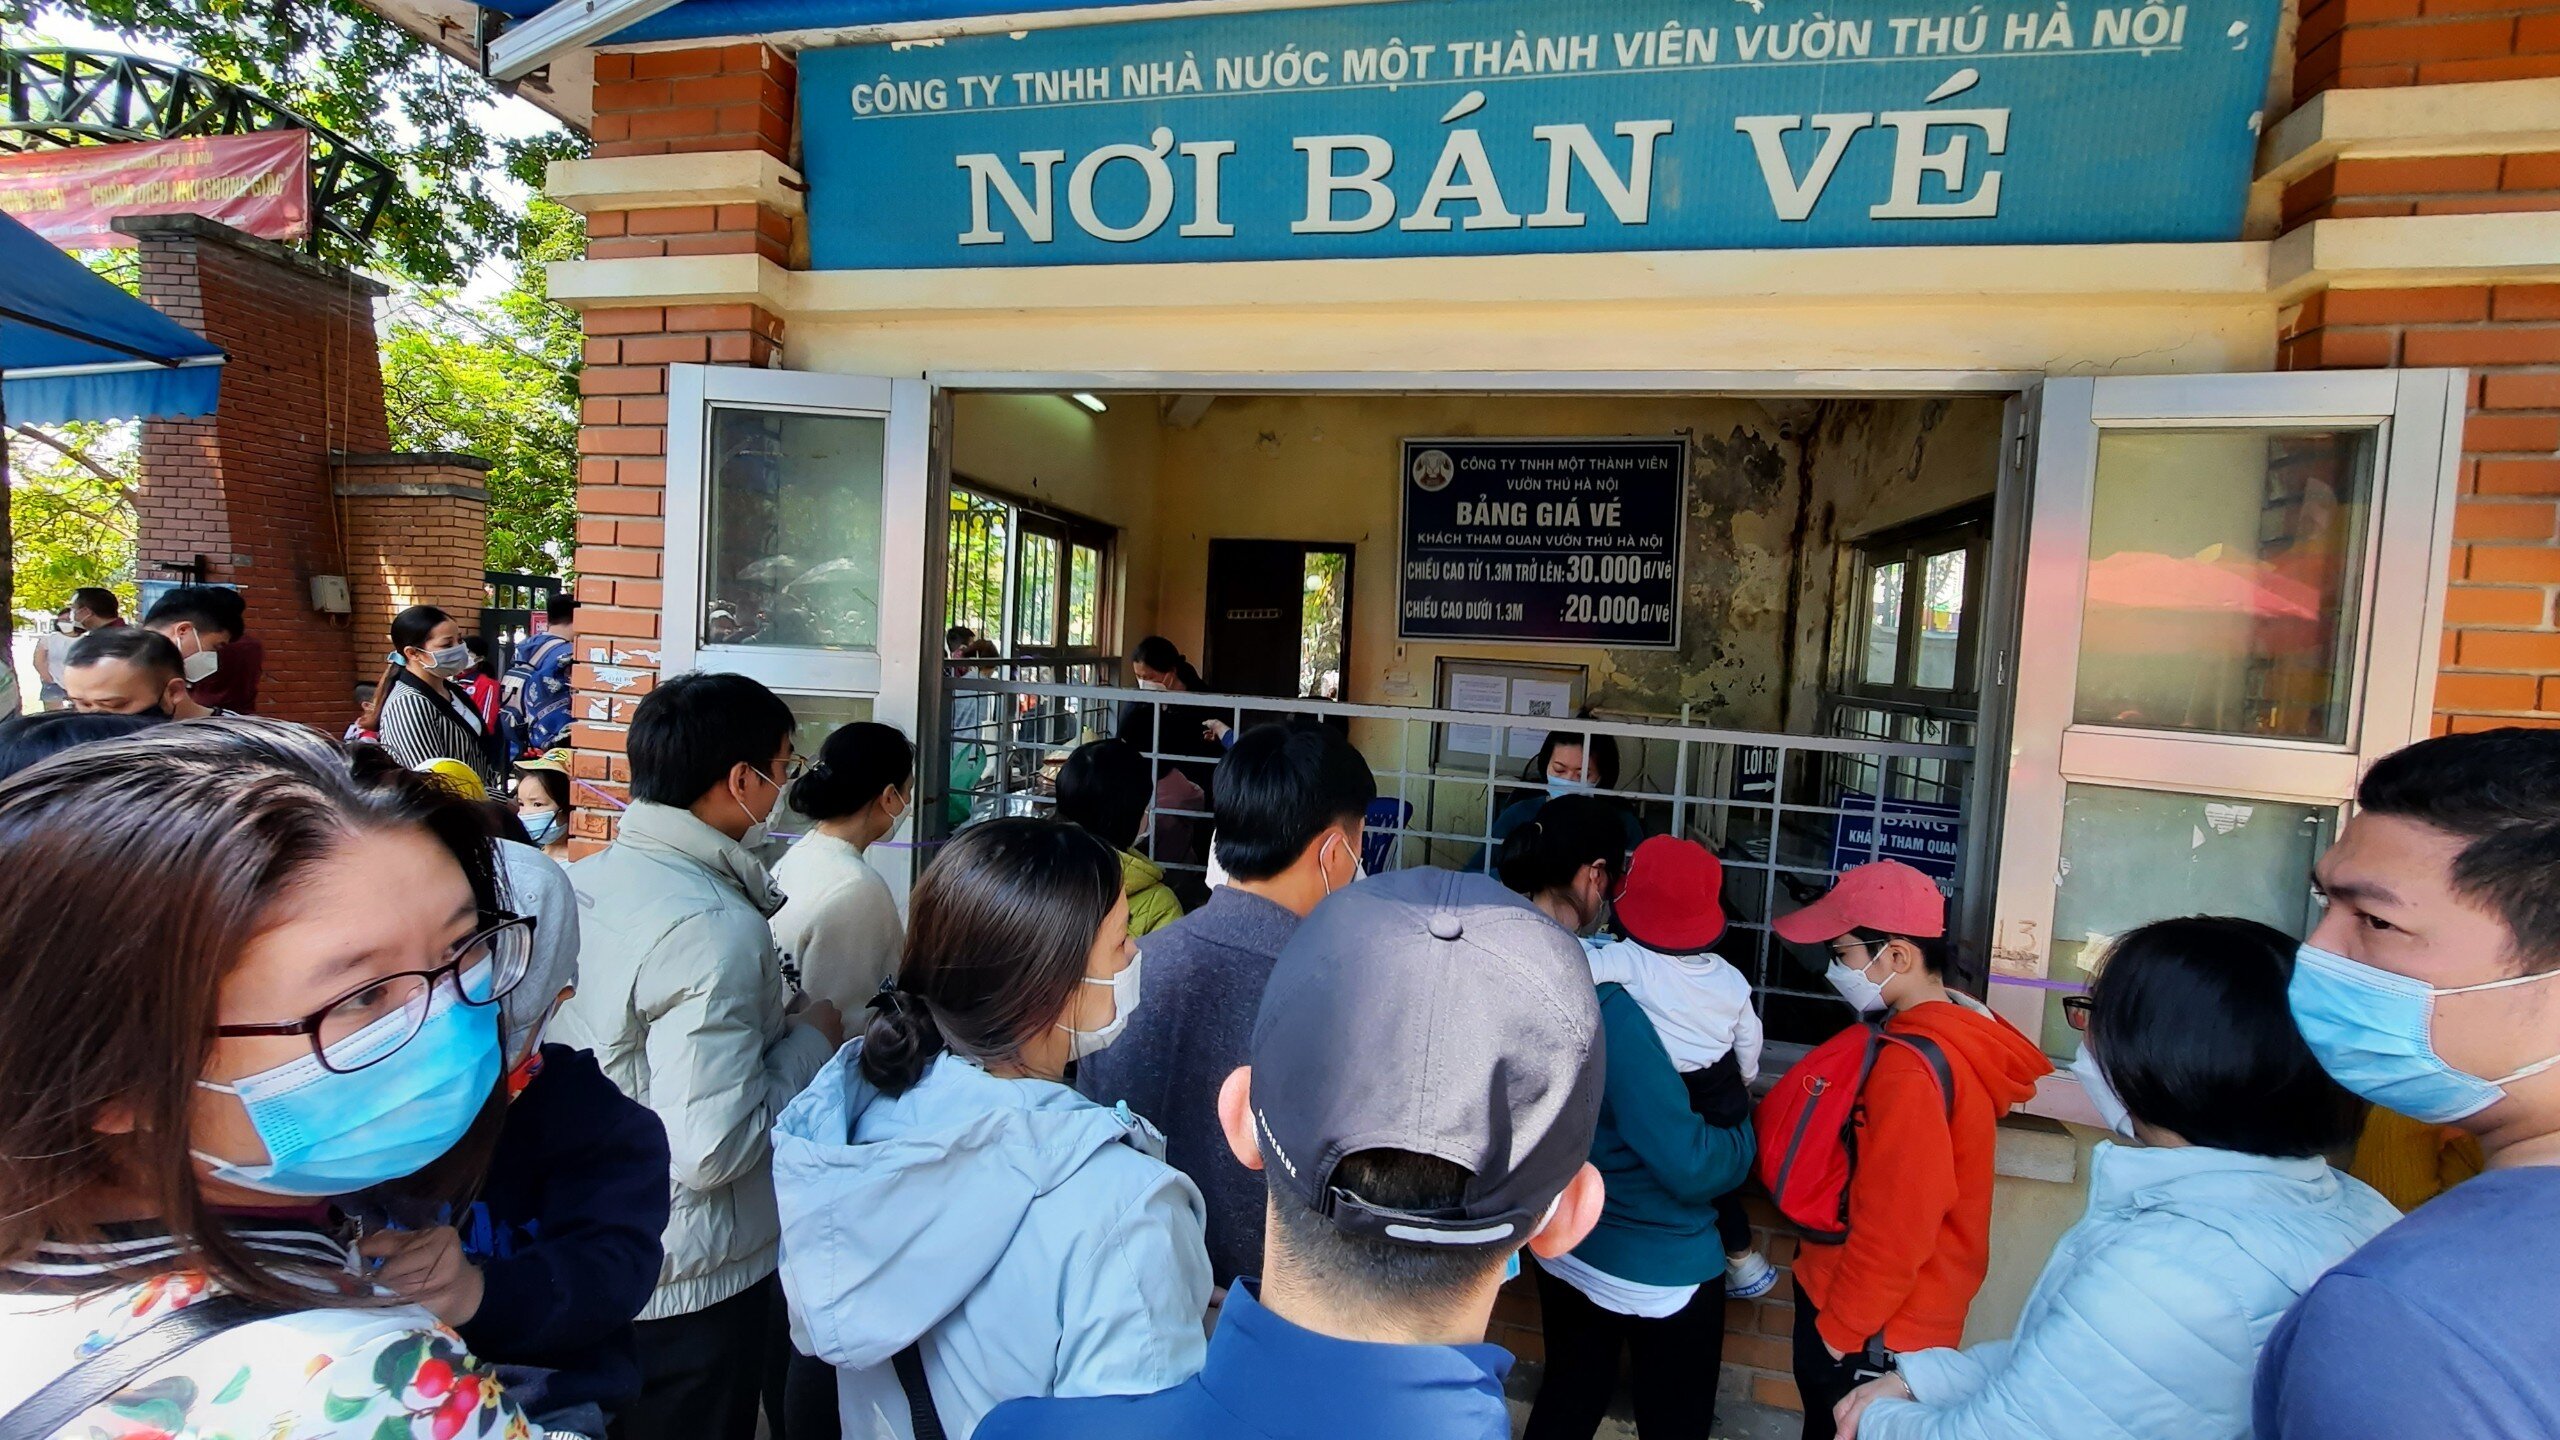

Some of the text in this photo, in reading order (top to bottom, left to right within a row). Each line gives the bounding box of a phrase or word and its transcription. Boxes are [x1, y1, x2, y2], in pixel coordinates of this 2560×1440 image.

[851, 0, 2187, 116] CÔNG TY TNHH NHÀ NƯỚC MỘT THÀNH VIÊN VƯỜN THÚ HÀ NỘI
[955, 67, 2010, 246] NƠI BÁN VÉ
[1460, 455, 1668, 472] CÔNG TY TNHH MỘT THÀNH VIÊN
[1507, 476, 1618, 493] VƯỜN THÚ HÀ NỘI
[1457, 493, 1621, 527] BẢNG GIÁ VÉ
[1418, 532, 1663, 549] KHÁCH THAM QUAN VƯỜN THÚ HÀ NỘI
[1443, 562, 1465, 581] CAO
[1485, 563, 1512, 581] 1.3M
[1516, 557, 1538, 582] TRỞ
[1567, 555, 1641, 584] 30.000
[1441, 601, 1463, 620] CAO
[1465, 598, 1492, 621] DƯỚI
[1495, 602, 1523, 622] 1.3M
[1848, 828, 1888, 847] KHÁH
[1890, 834, 1924, 852] THAM
